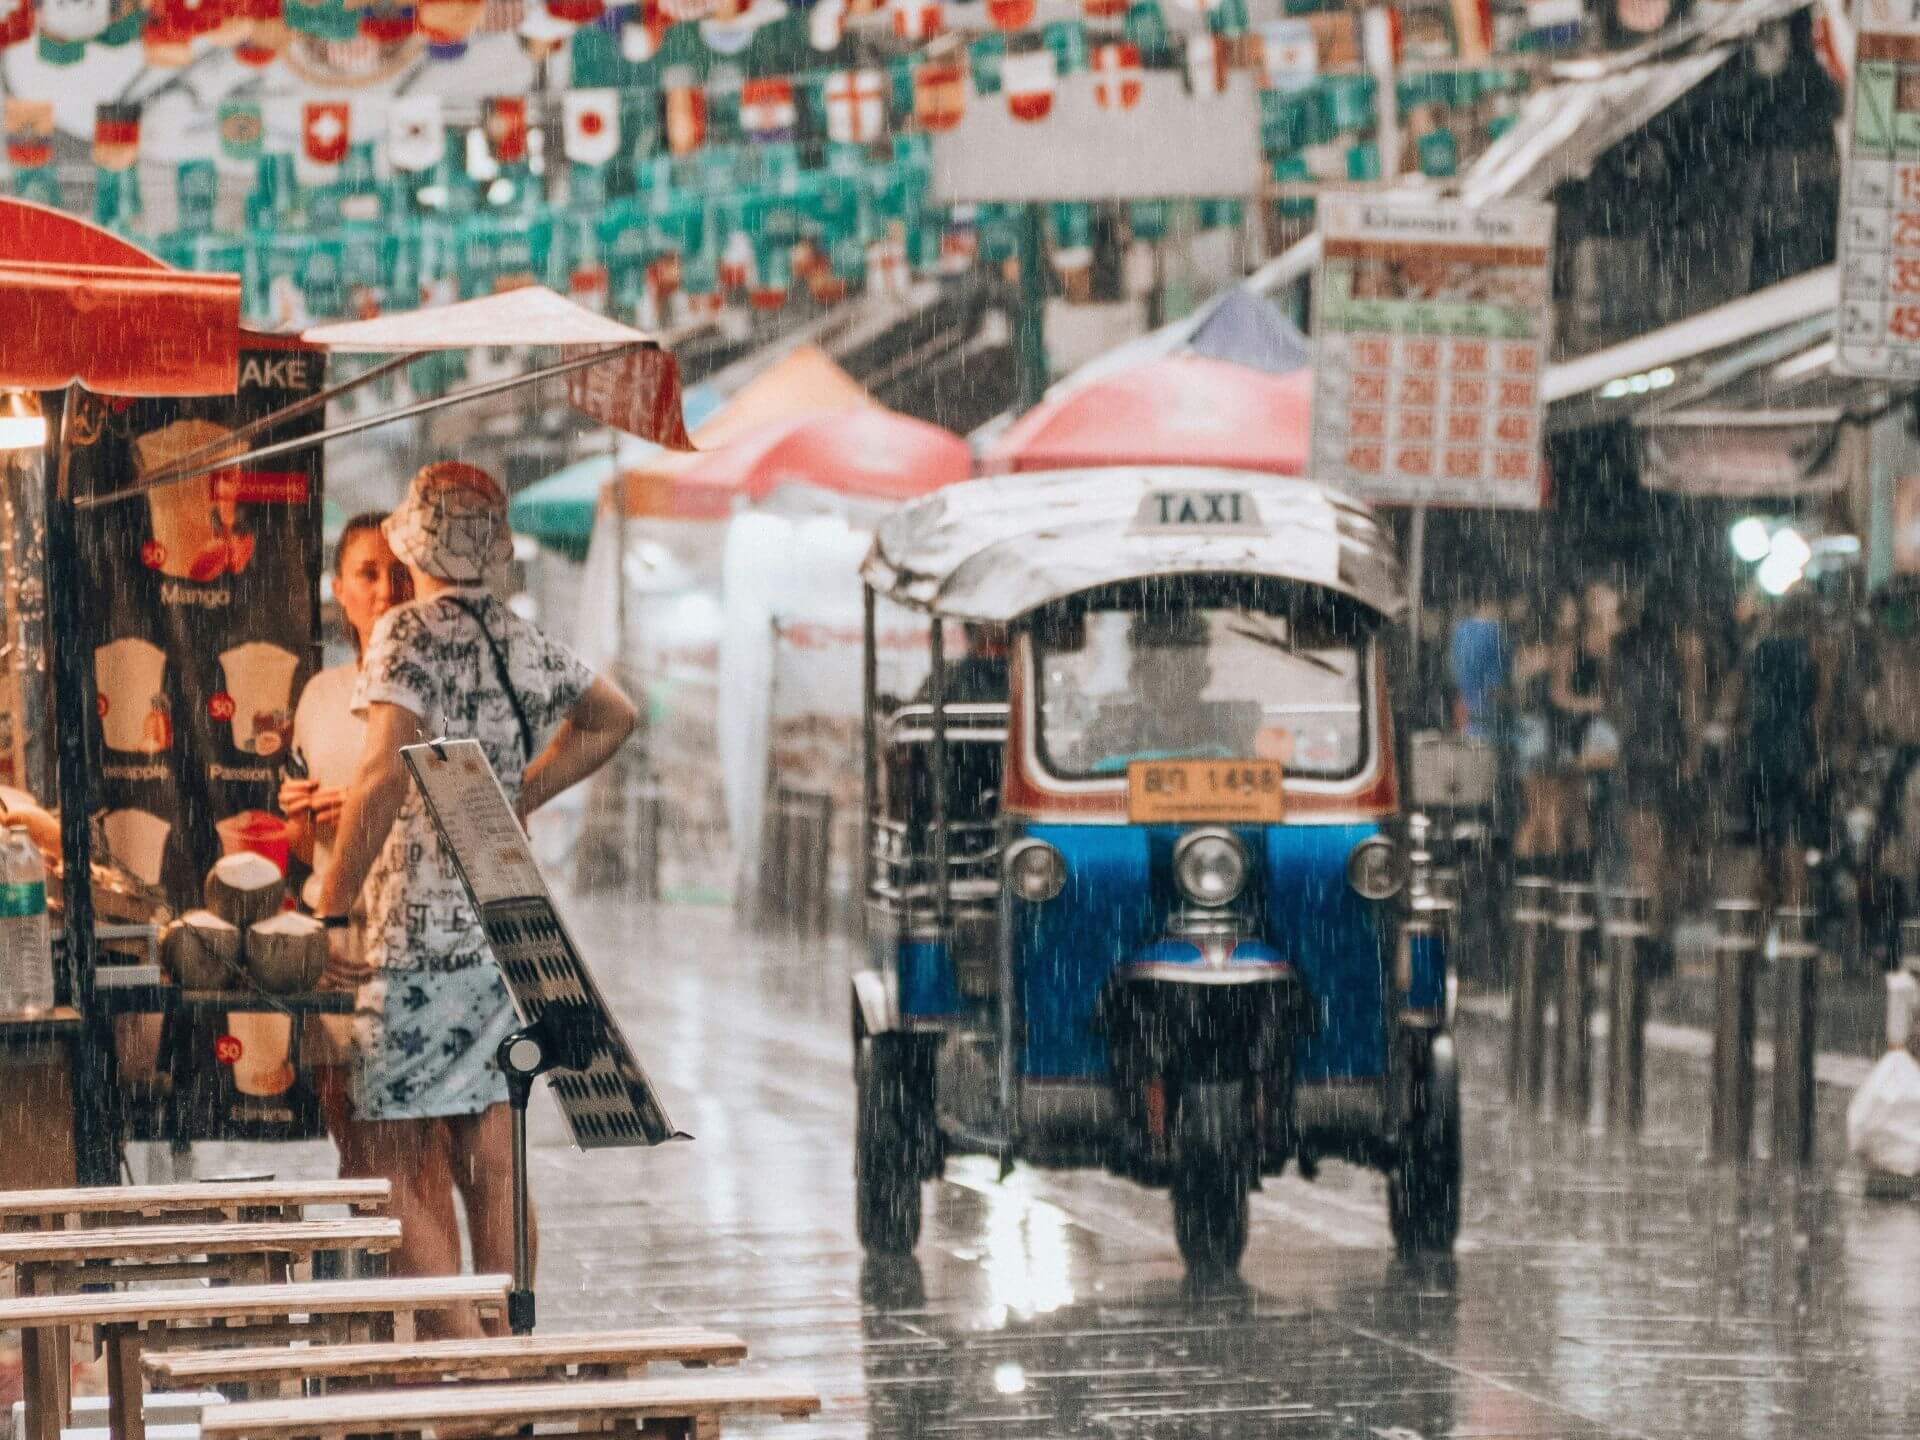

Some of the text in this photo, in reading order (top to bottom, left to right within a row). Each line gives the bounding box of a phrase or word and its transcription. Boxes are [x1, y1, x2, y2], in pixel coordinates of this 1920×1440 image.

[240, 358, 308, 389] AKE
[1153, 492, 1243, 524] TAXI
[160, 583, 231, 608] Mango
[210, 763, 272, 781] Passion
